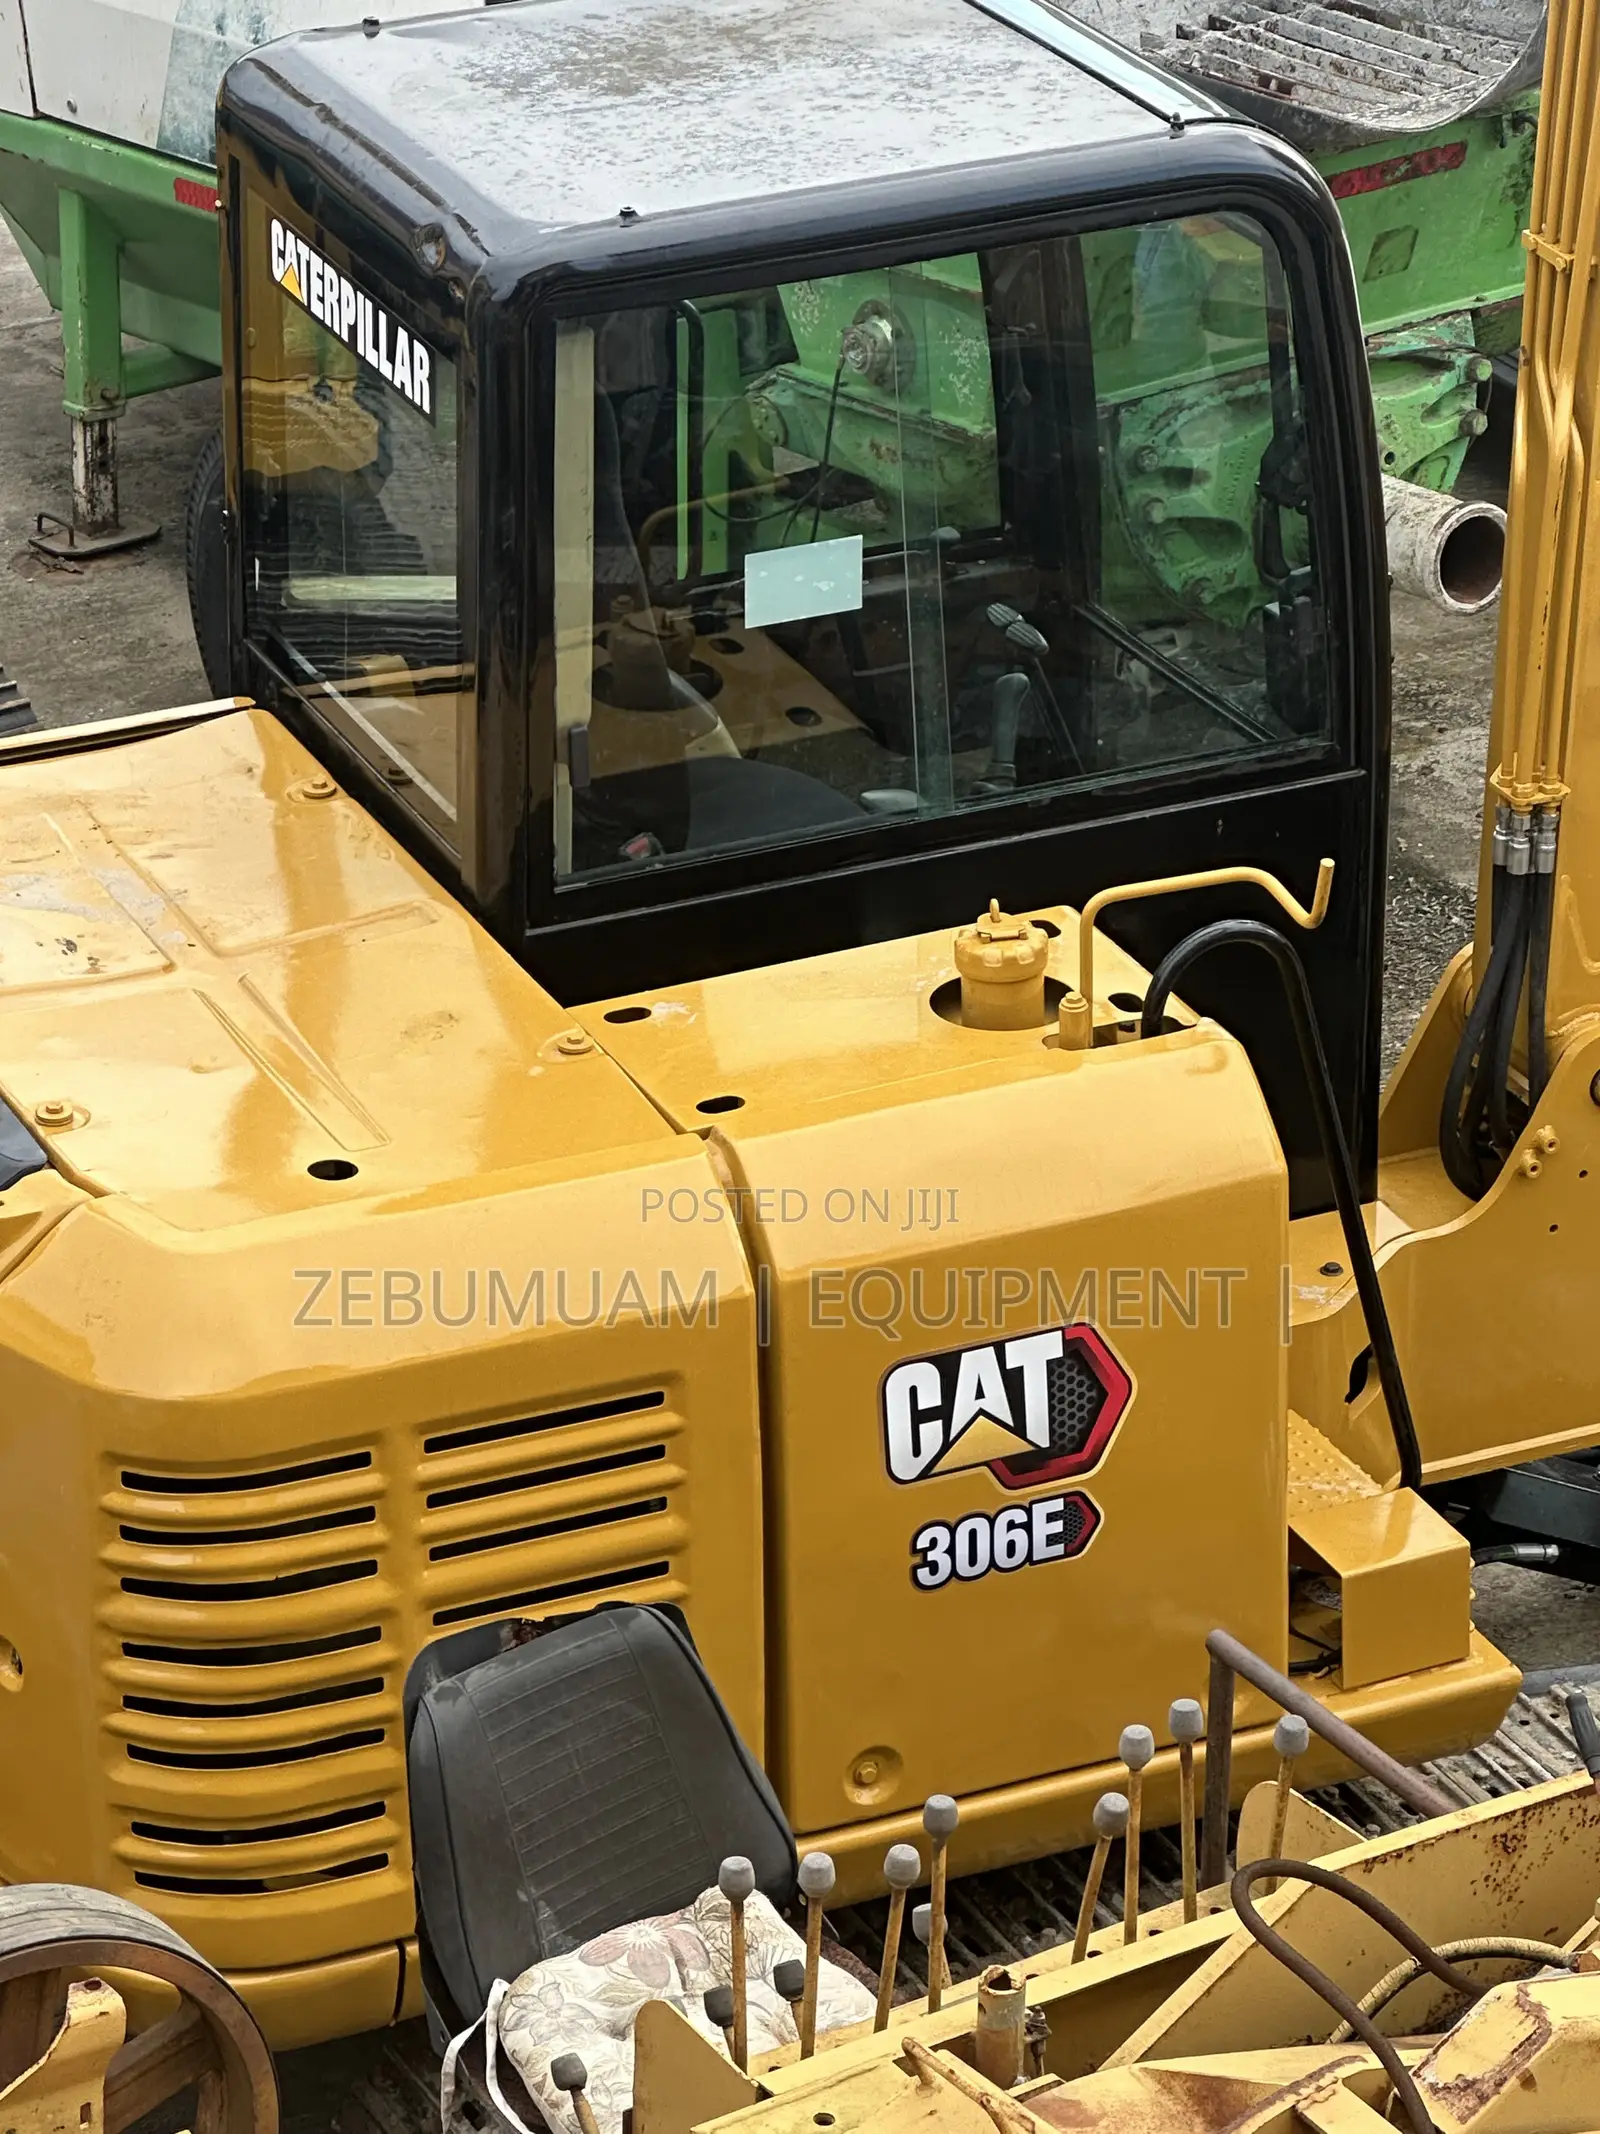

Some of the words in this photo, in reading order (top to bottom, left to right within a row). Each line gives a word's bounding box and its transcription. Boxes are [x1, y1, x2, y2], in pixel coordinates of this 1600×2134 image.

[271, 218, 430, 414] CATERPILLAR
[886, 1330, 1064, 1481] CAT
[916, 1498, 1064, 1586] 306E
